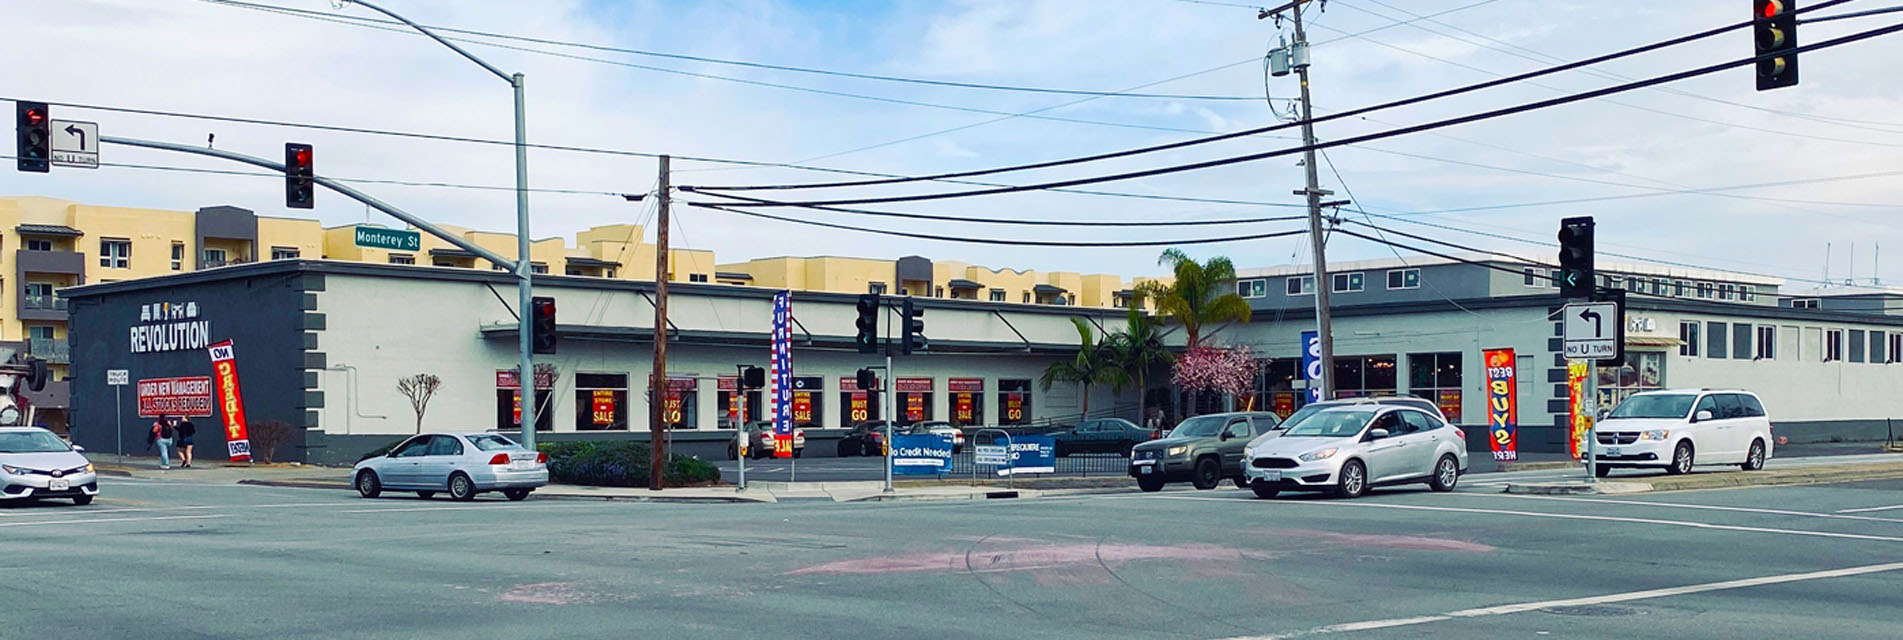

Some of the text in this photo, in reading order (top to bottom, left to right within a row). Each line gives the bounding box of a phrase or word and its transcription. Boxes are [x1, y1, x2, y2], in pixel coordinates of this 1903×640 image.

[67, 155, 75, 163] U
[357, 230, 418, 248] Monterey St
[130, 320, 209, 352] REVOLUTION
[1581, 344, 1589, 354] U
[1593, 345, 1612, 353] TURN
[141, 380, 208, 396] UNDER NEW MANAGEMENT
[593, 411, 614, 422] SALE
[794, 411, 811, 421] SALE
[851, 409, 867, 421] GO
[1008, 409, 1021, 420] GO
[899, 447, 922, 456] Credit
[923, 447, 951, 458] Needed
